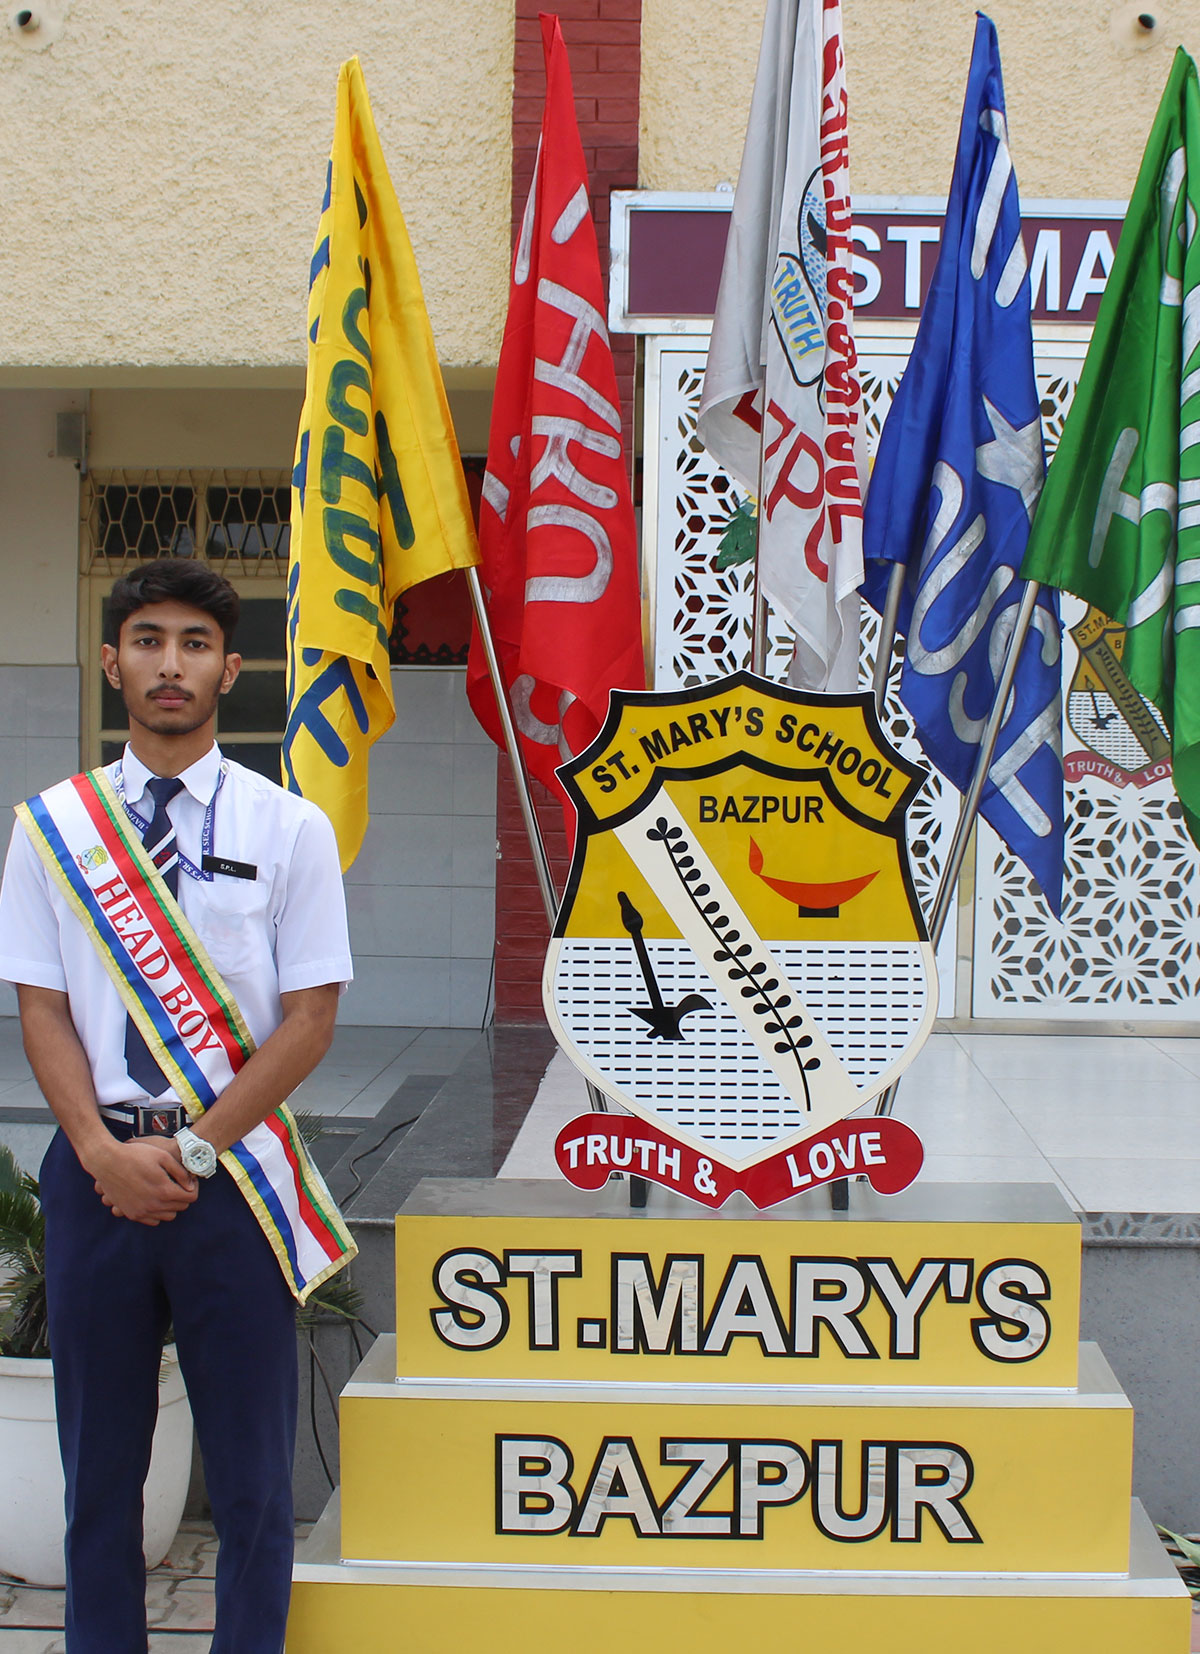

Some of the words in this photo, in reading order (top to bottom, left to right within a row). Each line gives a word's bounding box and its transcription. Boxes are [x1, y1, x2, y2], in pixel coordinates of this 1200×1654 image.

[771, 261, 825, 360] TRUTH
[591, 750, 641, 794] ST.
[638, 706, 764, 764] MARY'S
[775, 713, 893, 799] SCHOOL
[1067, 760, 1115, 778] TRUTH
[1114, 771, 1123, 784] &
[699, 795, 825, 823] BAZPUR
[93, 874, 171, 980] HEAD
[159, 982, 224, 1058] BOY
[563, 1134, 682, 1182] TRUTH
[693, 1157, 718, 1198] &
[785, 1131, 887, 1189] LOVE
[495, 1432, 984, 1543] BAZPUR
